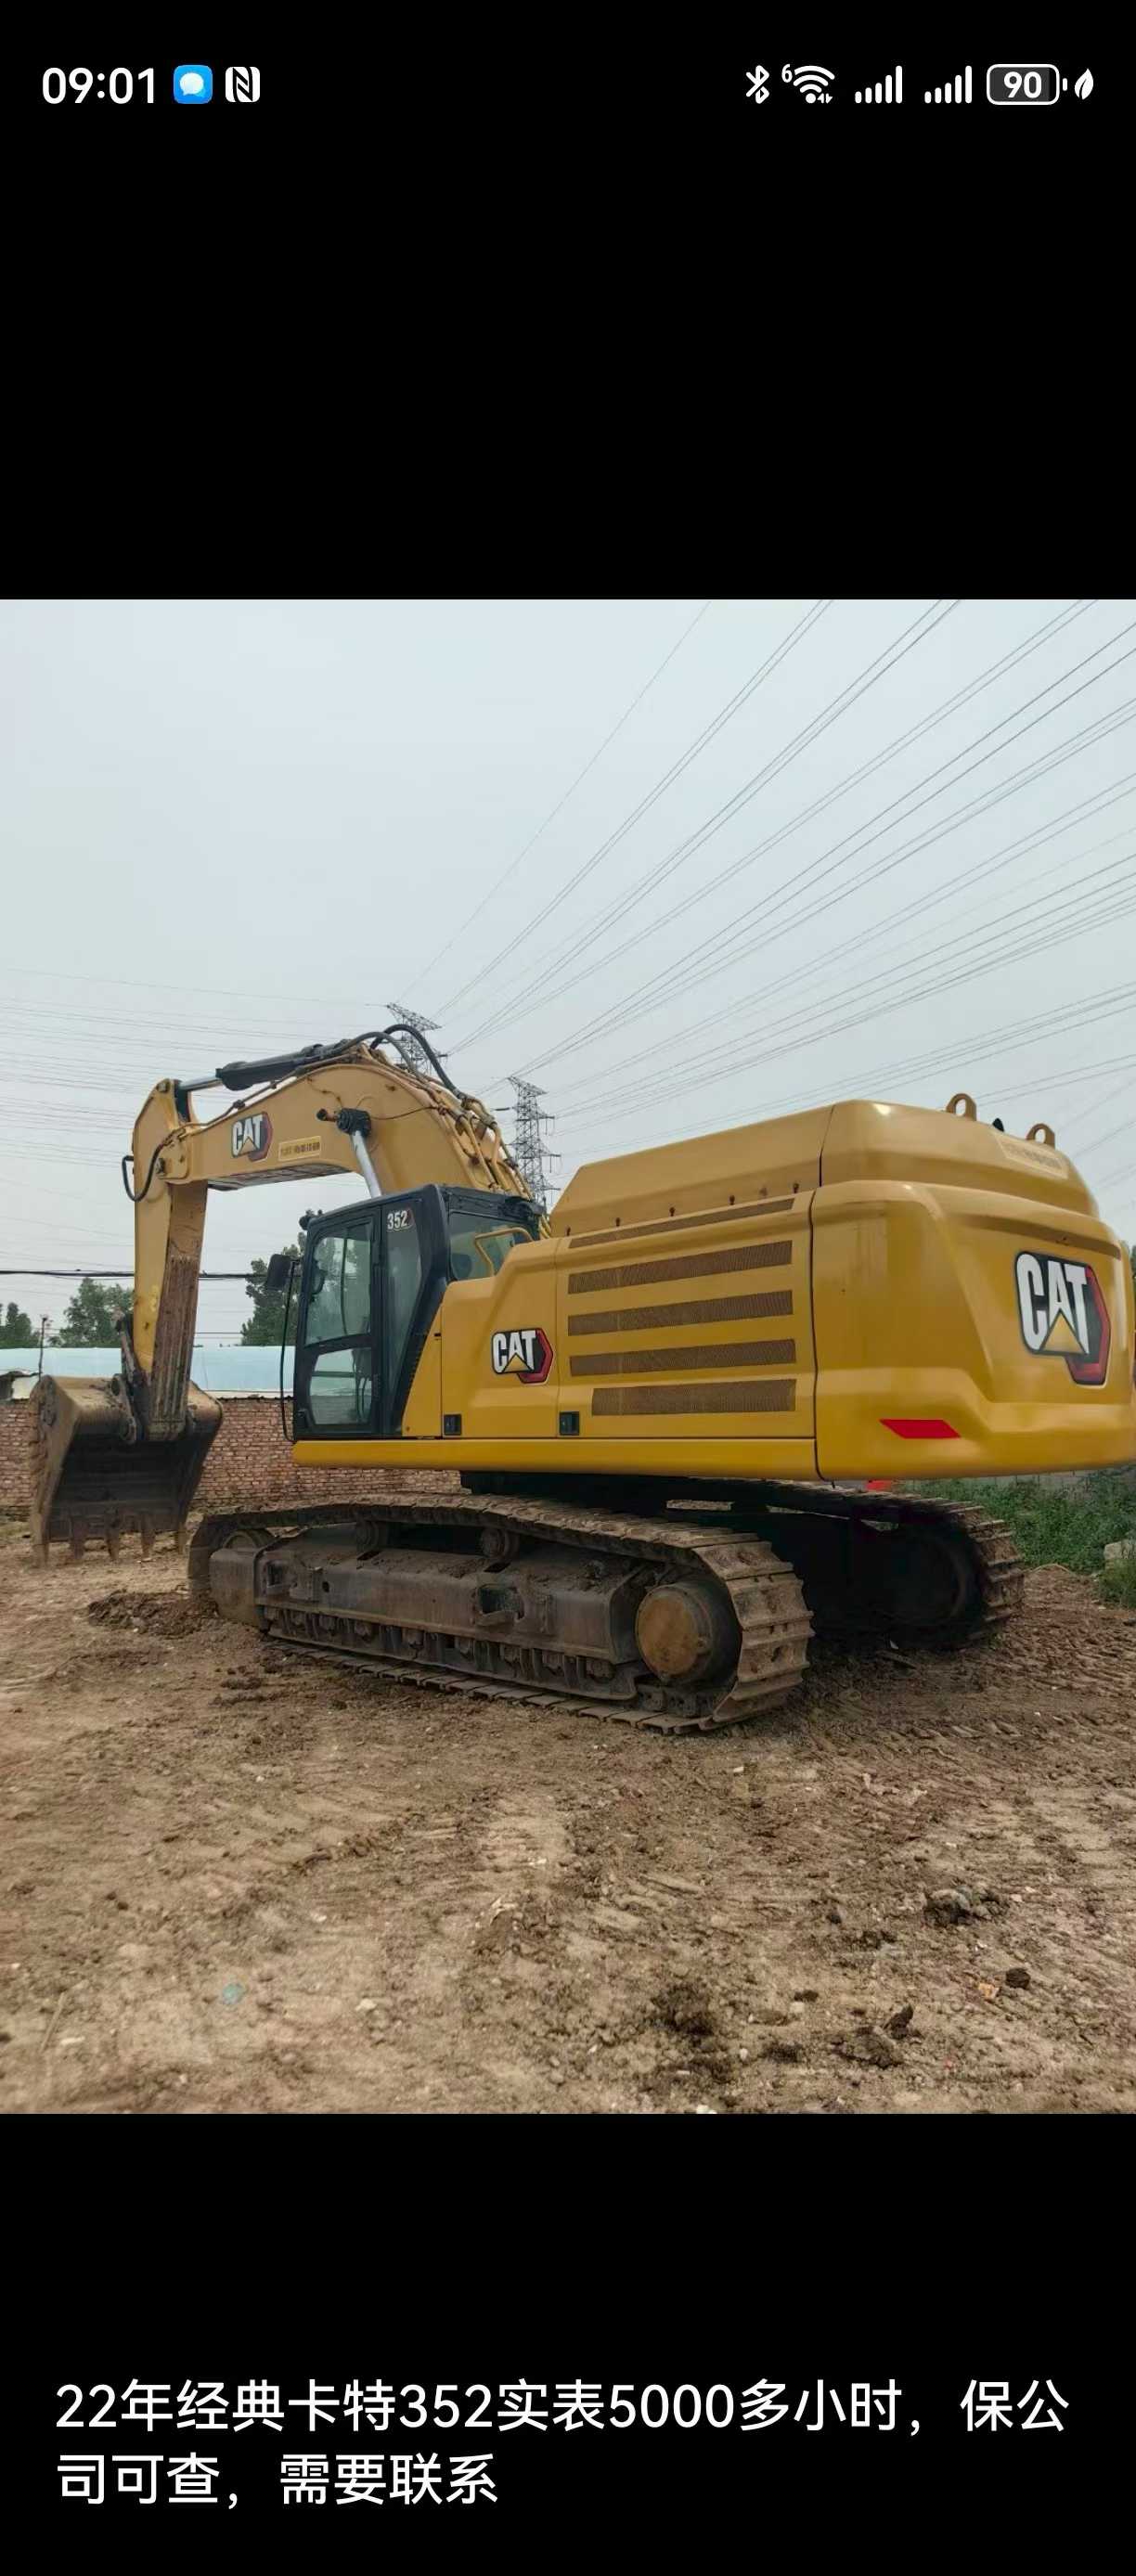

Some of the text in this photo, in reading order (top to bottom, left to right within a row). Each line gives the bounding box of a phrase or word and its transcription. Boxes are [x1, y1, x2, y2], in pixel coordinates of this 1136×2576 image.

[232, 1114, 264, 1156] CAT
[387, 1210, 408, 1230] 352
[1016, 1253, 1090, 1355] CAT
[492, 1330, 536, 1373] CAT
